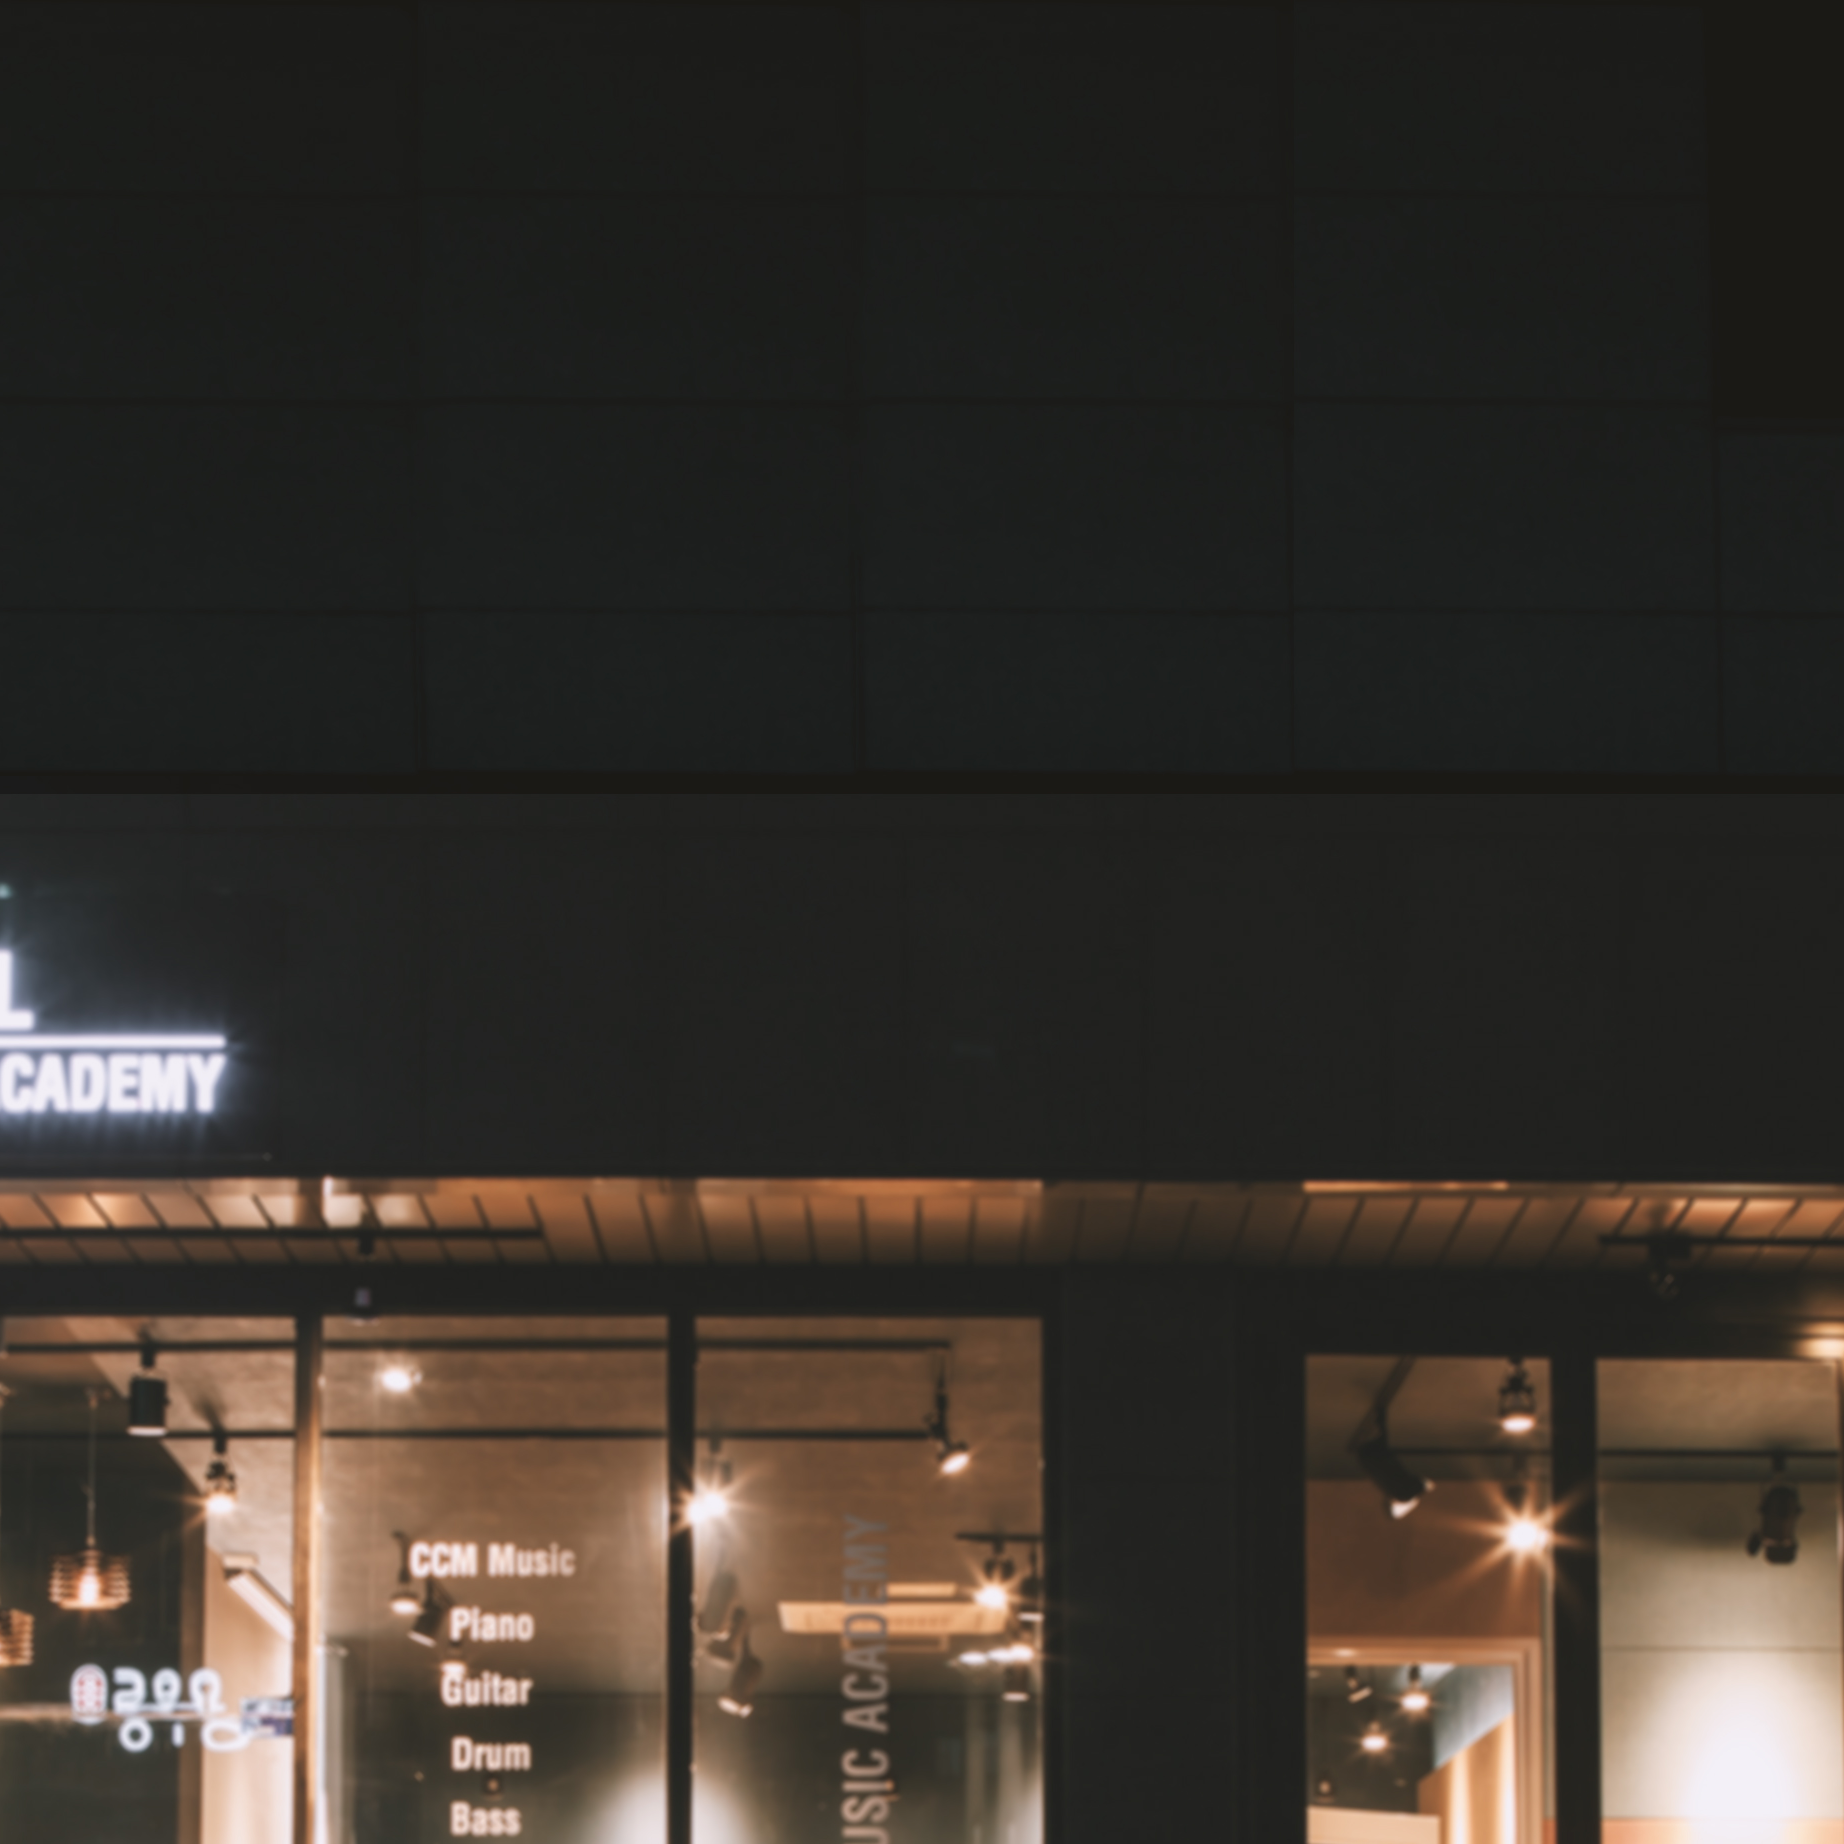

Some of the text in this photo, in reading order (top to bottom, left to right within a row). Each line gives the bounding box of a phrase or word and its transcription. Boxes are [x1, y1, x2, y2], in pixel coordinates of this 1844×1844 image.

[409, 1542, 576, 1577] CCM Music
[450, 1608, 535, 1642] Piano
[842, 1512, 891, 1734] ACADEMY
[441, 1671, 533, 1706] Guitar
[451, 1737, 532, 1771] Drum
[450, 1801, 522, 1836] Bass
